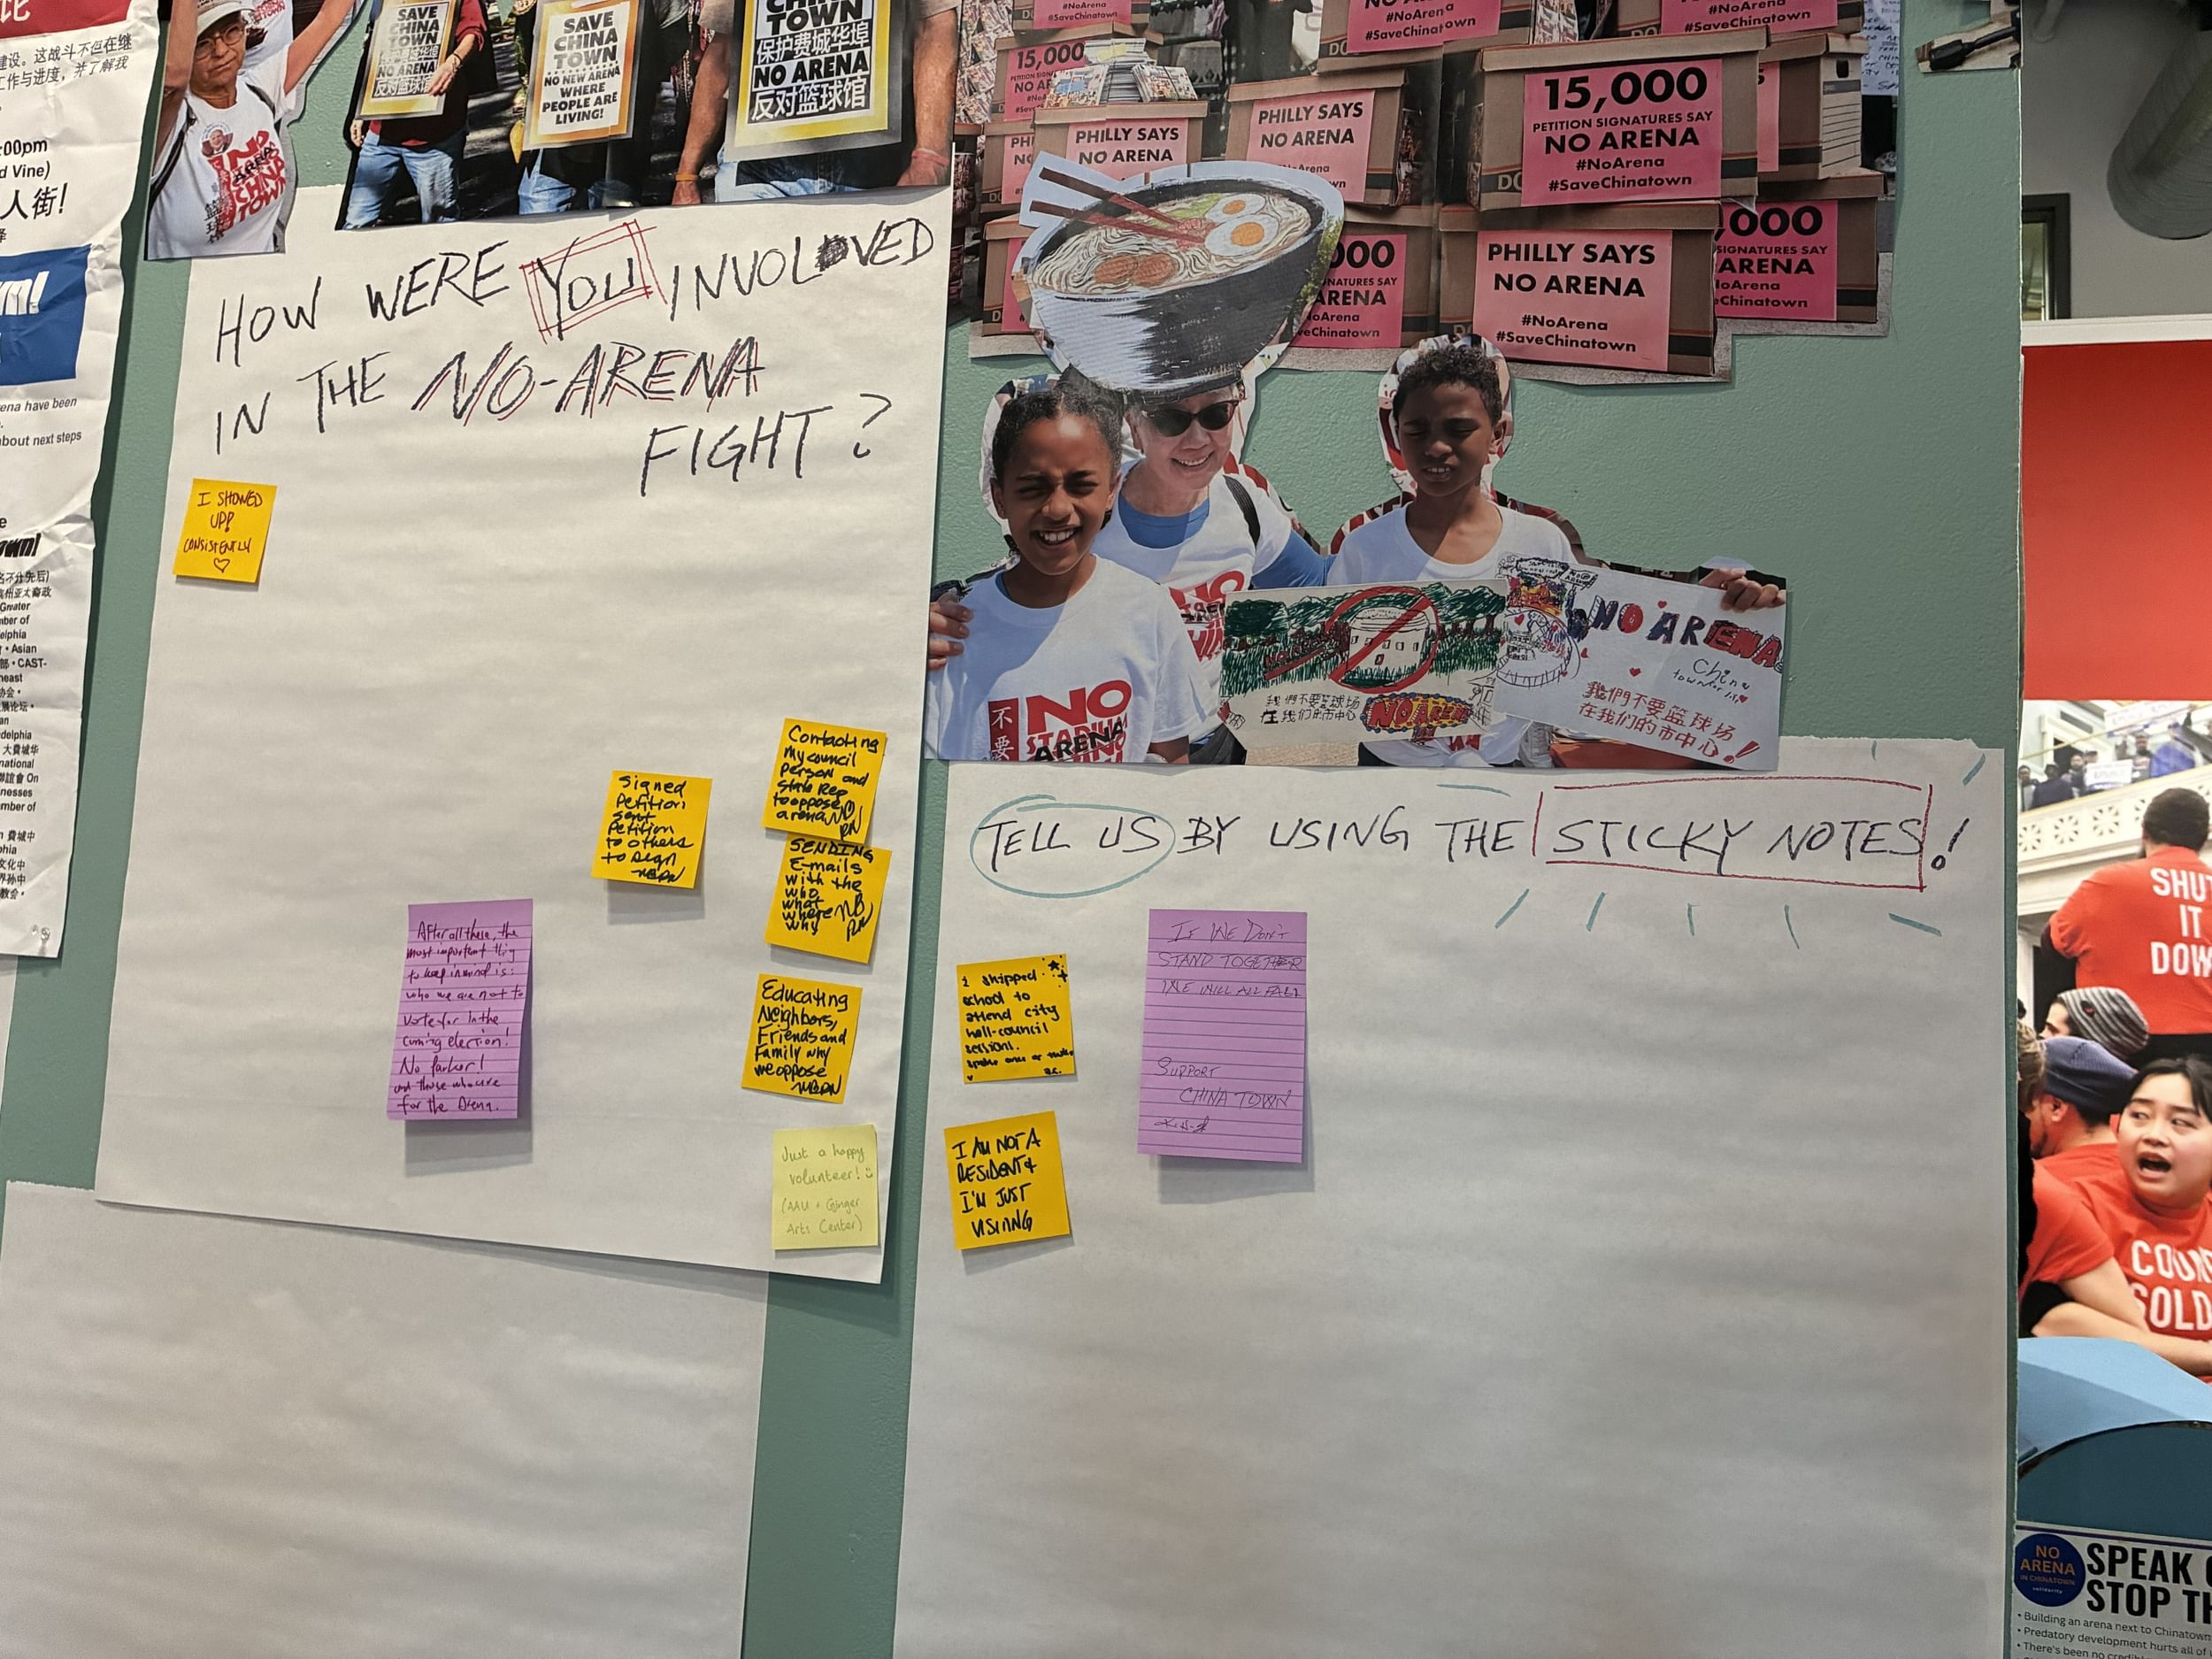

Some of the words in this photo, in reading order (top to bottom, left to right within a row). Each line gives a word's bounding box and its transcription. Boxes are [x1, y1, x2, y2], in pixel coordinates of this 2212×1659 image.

[397, 6, 438, 21] SAVE
[564, 11, 614, 34] SAVE
[766, 1, 872, 36] TOWN
[1685, 11, 1811, 33] #SaveChinatown
[390, 19, 440, 35] CHINA
[1365, 17, 1476, 41] #SaveChinatown
[389, 32, 439, 48] TOWN
[554, 28, 618, 52] CHINA
[757, 21, 870, 65] 保护费城华埠
[554, 45, 618, 70] TOWN
[1018, 42, 1085, 71] 15,000
[544, 75, 560, 87] NO
[562, 73, 586, 85] NEW
[588, 65, 621, 81] ARENA
[753, 64, 787, 88] NO
[795, 50, 870, 83] ARENA
[560, 82, 606, 98] WHERE
[751, 77, 867, 121] 反对篮球馆
[1543, 66, 1708, 114] 15,000
[541, 97, 590, 113] PEOPLE
[593, 92, 618, 105] ARE
[1258, 105, 1314, 125] PHILLY
[1317, 102, 1363, 119] SAYS
[555, 107, 603, 126] LIVING!
[1532, 118, 1592, 133] PETITION
[1596, 111, 1683, 128] SIGNATURES
[1686, 110, 1714, 123] SAY
[1075, 128, 1130, 143] PHILLY
[1136, 127, 1179, 142] SAYS
[1260, 133, 1287, 148] NO
[1291, 128, 1355, 147] ARENA
[1545, 134, 1591, 155] NO
[1598, 127, 1699, 150] ARENA
[1079, 150, 1107, 165] NO
[1111, 149, 1173, 163] ARENA
[1576, 156, 1665, 172] #NoArena
[13, 160, 50, 180] Vine)
[1548, 173, 1693, 192] #SaveChinatown
[1487, 242, 1575, 262] PHILLY
[1582, 243, 1656, 265] SAYS
[1494, 273, 1537, 292] NO
[1543, 274, 1646, 297] ARENA
[217, 275, 322, 368] HOW
[365, 240, 511, 322] WERE
[536, 236, 635, 342] YOU
[1521, 314, 1609, 332] #NoArena
[1495, 331, 1637, 353] #SaveChinatown
[24, 399, 50, 412] have
[52, 396, 78, 409] been
[216, 391, 271, 456] IN
[296, 351, 391, 434] THE
[411, 336, 766, 425] NO-ARENA
[33, 433, 54, 446] next
[57, 430, 82, 445] steps
[196, 491, 212, 507] I
[217, 489, 264, 508] SHOWED
[210, 511, 235, 534] UP!
[1589, 595, 1645, 634] NO
[1646, 611, 1783, 672] ARENA
[1025, 680, 1133, 736] NO
[788, 725, 879, 753] Contacting
[1034, 720, 1125, 762] ARENA
[807, 751, 857, 767] council
[842, 772, 870, 787] and
[790, 797, 841, 810] oppose
[606, 837, 623, 849] to
[627, 835, 695, 849] others
[789, 838, 874, 864] SENDING
[978, 819, 1071, 873] TELL
[1099, 815, 1163, 854] US
[1177, 814, 1241, 856] BY
[1269, 804, 1410, 852] USING
[1433, 817, 1516, 864] THE
[1552, 817, 1754, 877] STICKY
[601, 852, 626, 864] to
[789, 856, 864, 874] E-mails
[785, 872, 824, 886] with
[831, 877, 863, 893] the
[782, 895, 825, 910] what
[497, 920, 519, 940] the
[2179, 904, 2203, 939] IT
[436, 941, 487, 964] important
[1157, 951, 1215, 969] STAND
[1220, 952, 1304, 972] TOGETHER
[405, 987, 429, 1002] who
[437, 991, 452, 1002] we
[479, 988, 508, 1001] not
[762, 979, 849, 1012] Educating
[1014, 991, 1031, 1002] to
[1236, 982, 1262, 997] ALL
[757, 1004, 839, 1032] Neighbors,
[965, 1008, 1012, 1023] attend
[1025, 1003, 1061, 1022] city
[448, 1026, 510, 1048] election!
[757, 1024, 818, 1045] Friends
[819, 1028, 848, 1045] and
[399, 1054, 420, 1075] No
[755, 1043, 803, 1064] Family
[806, 1046, 832, 1067] why
[754, 1063, 776, 1077] we
[775, 1064, 827, 1082] oppose
[1154, 1056, 1223, 1079] SUPPORT
[417, 1076, 447, 1092] those
[397, 1094, 422, 1116] for
[426, 1094, 449, 1115] the
[1179, 1086, 1229, 1107] CHINA
[1233, 1088, 1292, 1110] TOWN
[781, 1146, 809, 1162] Just
[832, 1143, 865, 1164] happy
[951, 1141, 968, 1160] I
[996, 1132, 1026, 1154] NOT
[1025, 1127, 1041, 1150] A
[789, 1166, 861, 1185] volunteer!
[826, 1197, 860, 1214] Ginger
[959, 1190, 987, 1213] I'M
[995, 1182, 1033, 1208] JUST
[786, 1223, 811, 1236] Arts
[818, 1214, 864, 1234] Center)
[2035, 1545, 2060, 1559] NO
[2020, 1558, 2076, 1576] ARENA
[2086, 1542, 2193, 1586] SPEAK
[2028, 1575, 2076, 1586] CHINATOWN
[2086, 1578, 2171, 1619] STOP
[2024, 1611, 2066, 1627] Building
[2069, 1617, 2081, 1627] an
[2083, 1619, 2113, 1631] arena
[2115, 1624, 2138, 1634] next
[2140, 1625, 2152, 1635] to
[2154, 1626, 2211, 1641] Chinatown
[2024, 1626, 2076, 1643] Predatory
[2078, 1633, 2147, 1650] development
[2150, 1642, 2178, 1655] hurts
[2180, 1646, 2193, 1655] all
[2196, 1647, 2208, 1658] of
[2024, 1641, 2061, 1655] There's
[2063, 1645, 2089, 1658] been
